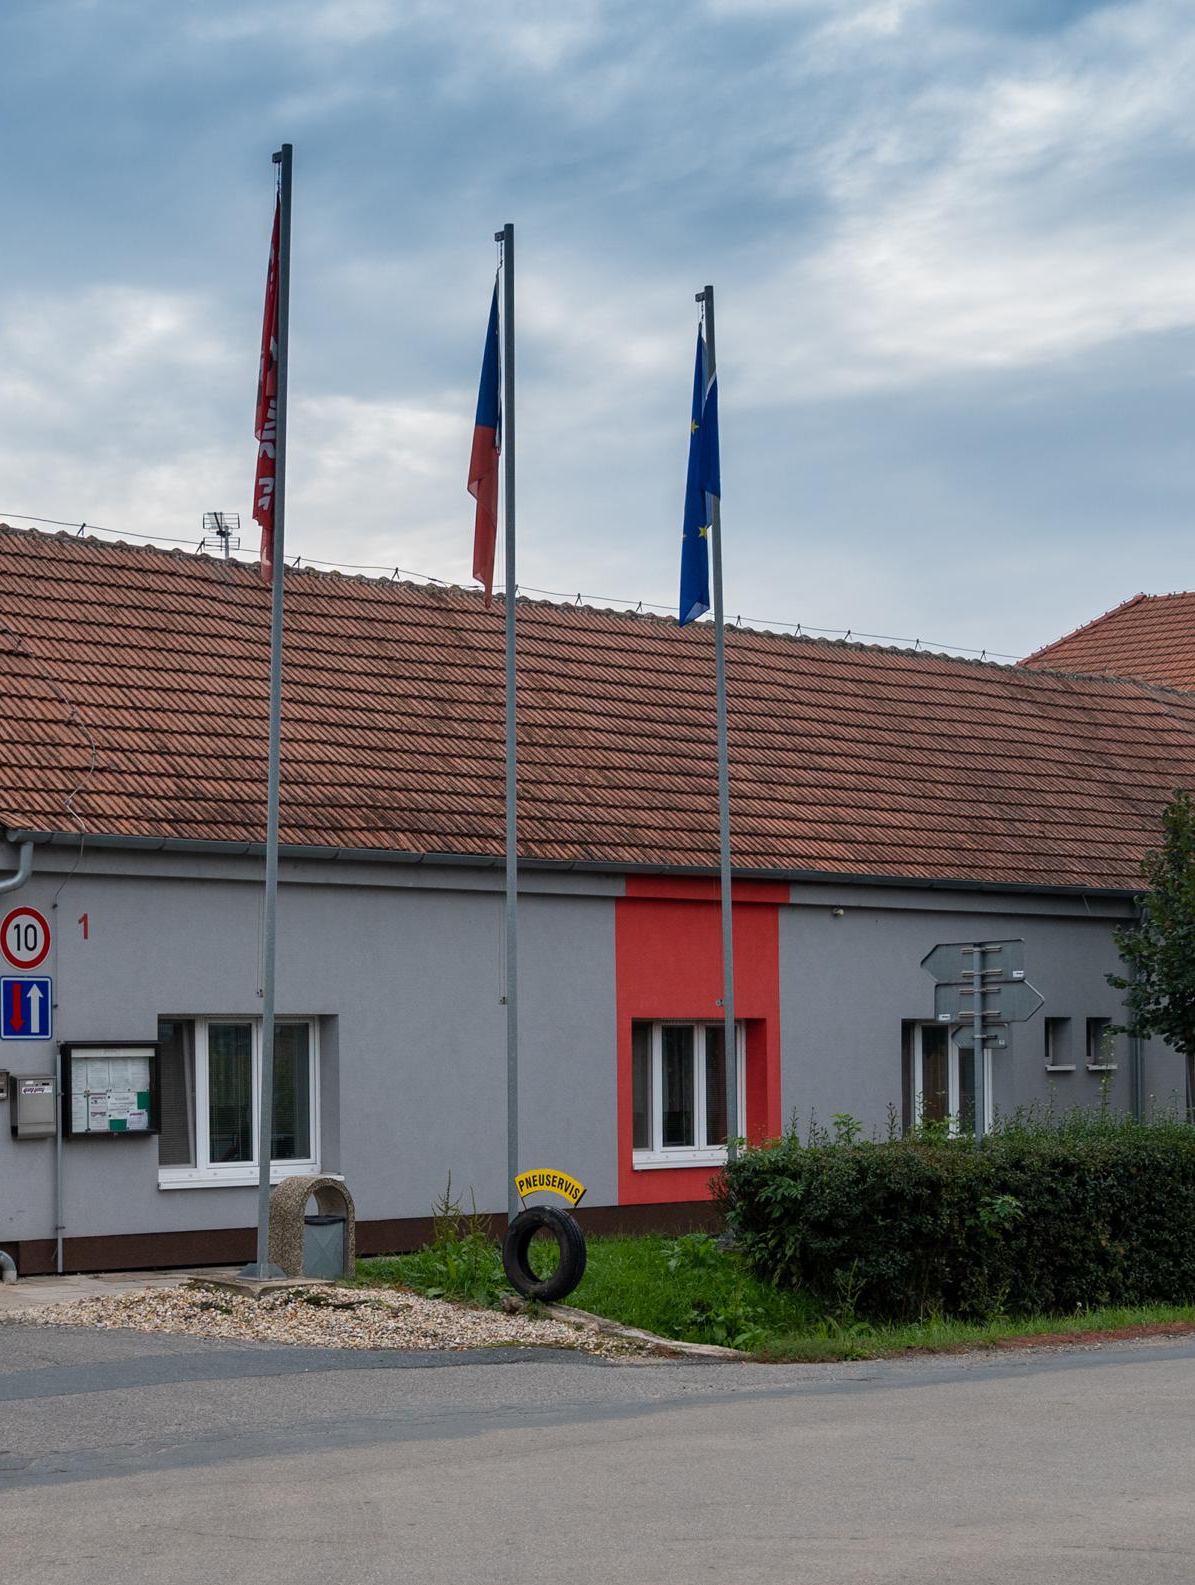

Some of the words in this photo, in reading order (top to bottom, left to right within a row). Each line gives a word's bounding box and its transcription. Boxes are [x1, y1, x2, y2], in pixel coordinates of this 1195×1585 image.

[13, 923, 38, 951] 10
[78, 913, 89, 940] 1
[518, 1174, 581, 1200] PNEUSERVIS
